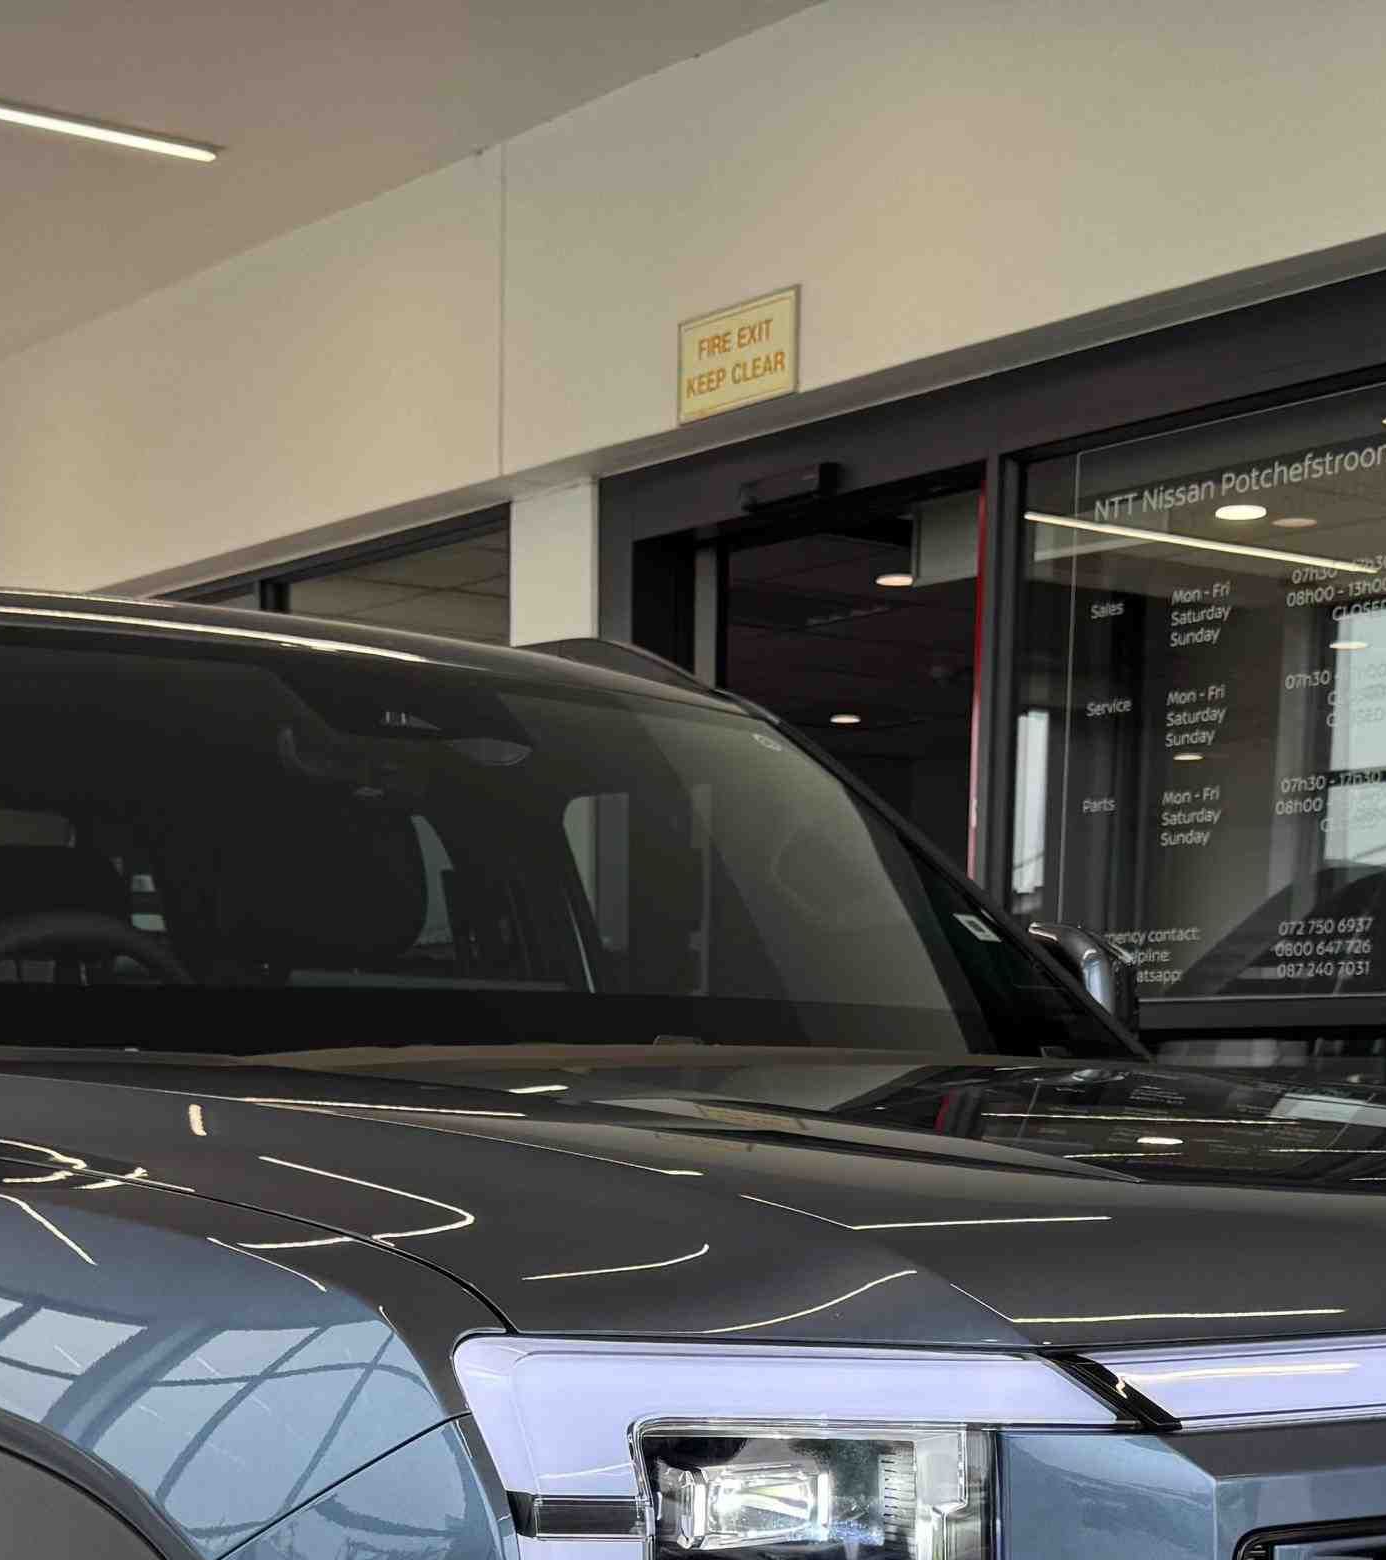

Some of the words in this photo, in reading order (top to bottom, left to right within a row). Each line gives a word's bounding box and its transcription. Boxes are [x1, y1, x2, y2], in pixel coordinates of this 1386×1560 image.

[698, 331, 732, 360] FIRE
[737, 318, 774, 349] EXIT
[685, 366, 727, 400] KEEP
[731, 350, 786, 385] CLEAR
[1094, 493, 1139, 521] NTT
[1142, 480, 1214, 513] Nissan
[1170, 588, 1203, 605] Mon
[1212, 581, 1231, 597] Fri
[1286, 585, 1335, 608] 08h00
[1090, 602, 1125, 620] Sales
[1170, 604, 1232, 627] Saturday
[1169, 627, 1222, 648] Sunday
[1284, 670, 1331, 690] 07h30
[1166, 690, 1198, 706] Mon
[1208, 684, 1226, 701] Fri
[1086, 698, 1132, 717] Service
[1165, 705, 1227, 727] Saturday
[1165, 728, 1216, 748] Sunday
[1280, 774, 1325, 794] 07h30
[1161, 791, 1192, 806] Mon
[1202, 785, 1221, 802] Fri
[1082, 798, 1116, 814] Parts
[1275, 797, 1324, 816] 08h00
[1161, 807, 1222, 827] Saturday
[1160, 830, 1211, 848] Sunday
[1277, 919, 1305, 936] 072
[1307, 918, 1335, 935] 750
[1337, 917, 1373, 934] 6937
[1275, 941, 1312, 958] 0800
[1316, 940, 1344, 956] 647
[1276, 962, 1303, 979] 087
[1307, 962, 1334, 977] 240
[1337, 960, 1371, 977] 7031
